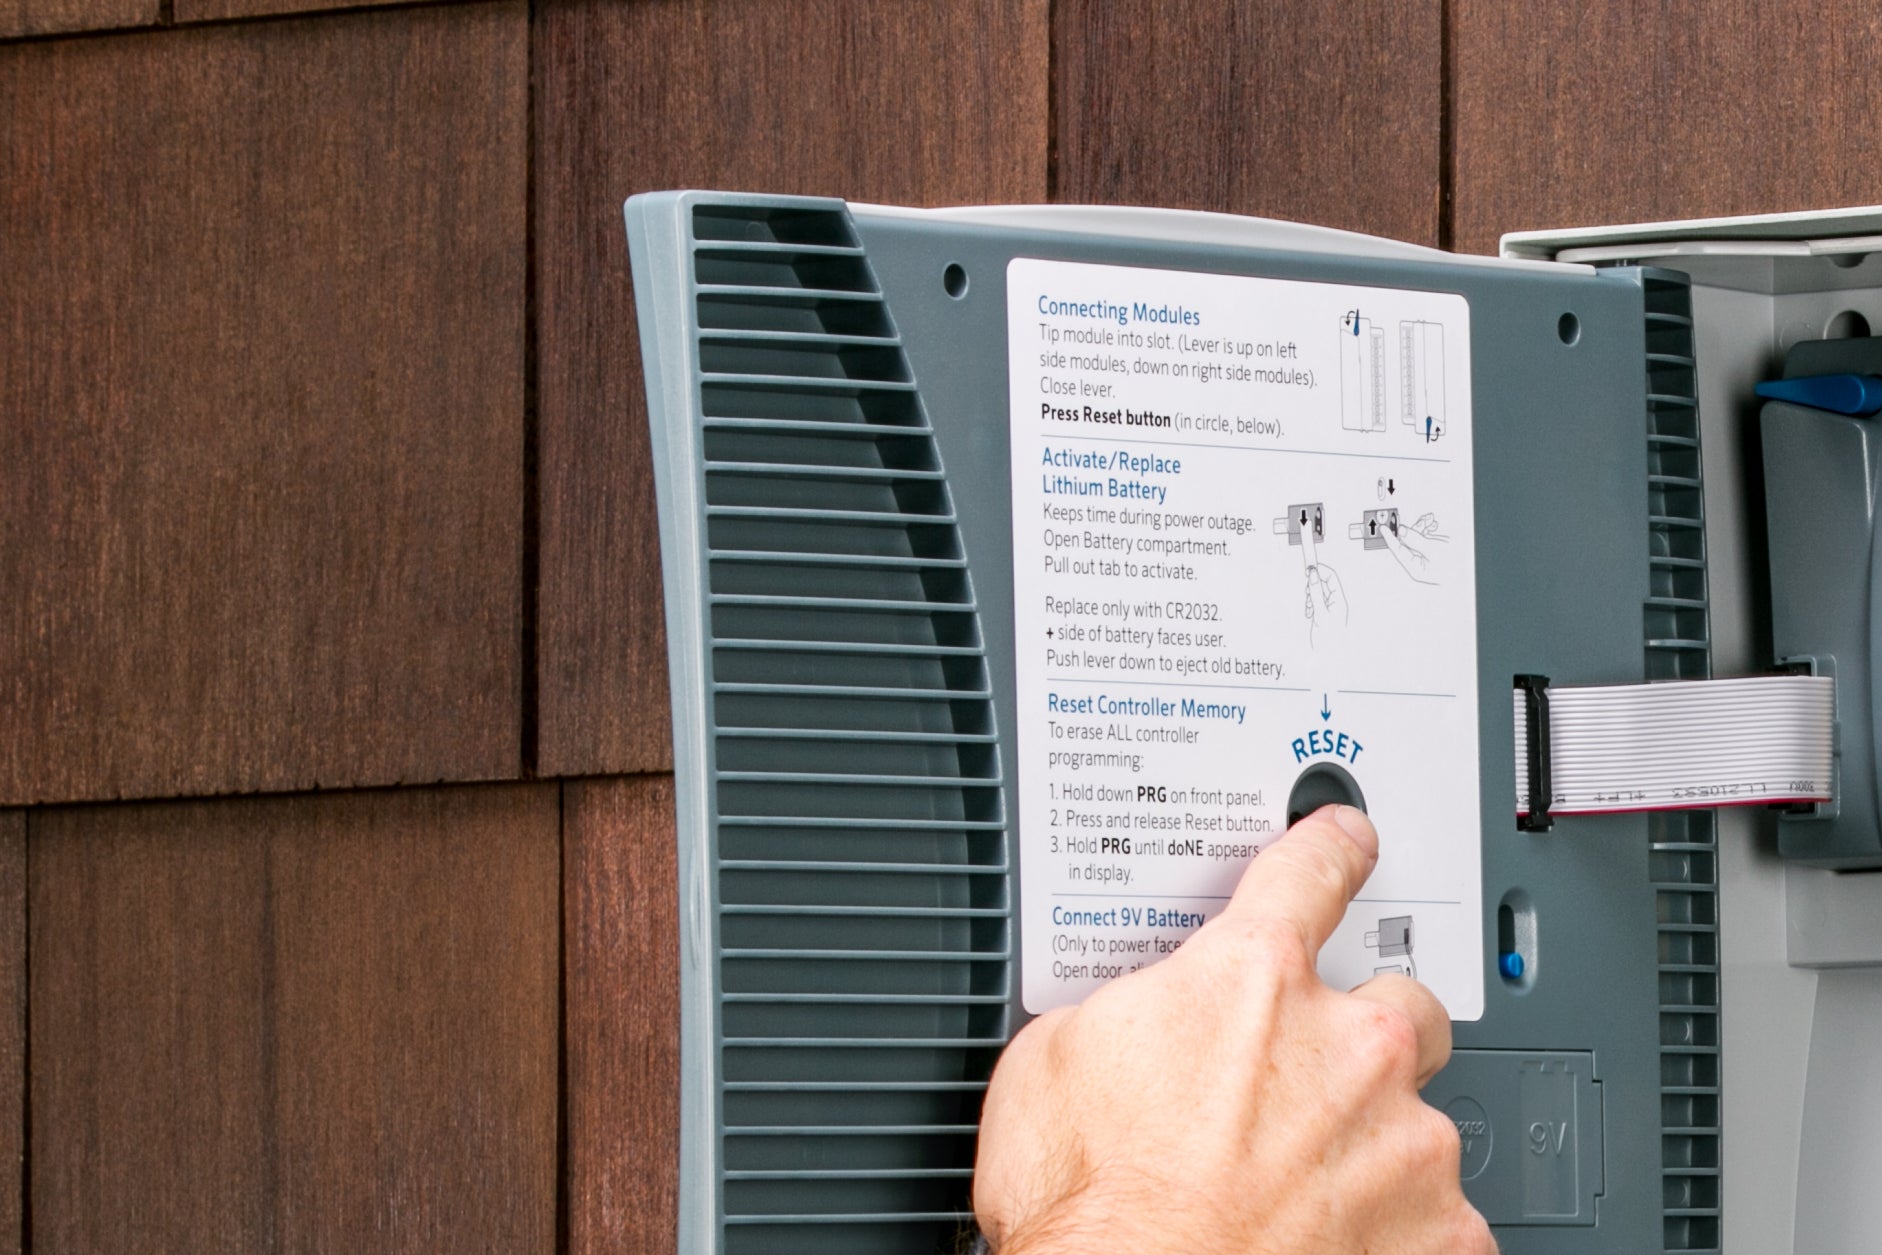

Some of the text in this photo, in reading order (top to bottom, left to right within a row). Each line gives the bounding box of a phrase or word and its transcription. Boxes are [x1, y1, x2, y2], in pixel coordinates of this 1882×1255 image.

[1038, 295, 1200, 326] Connecting Modules
[1039, 323, 1297, 360] Tip module into slot. (Lever is up on left
[1040, 350, 1317, 389] side modules, down on right side modules).
[1040, 376, 1115, 398] Close lever.
[1041, 403, 1284, 439] Press Reset button (in circle, below).
[1042, 446, 1181, 477] Activate/Replace
[1043, 474, 1167, 506] Lithium Battery
[1043, 502, 1255, 535] Keeps time during power outage.
[1044, 529, 1230, 557] Open Battery compartment.
[1045, 555, 1197, 580] Pull out tab to activate.
[1045, 596, 1222, 621] Replace only with CR2032.
[1058, 624, 1085, 641] side
[1088, 624, 1102, 642] of
[1105, 625, 1154, 648] battery
[1157, 627, 1191, 646] faces
[1195, 634, 1226, 647] user.
[1047, 649, 1285, 680] Push lever down to eject old battery.
[1048, 693, 1246, 725] Reset Controller Memory
[1048, 721, 1199, 744] To erase ALL controller
[1292, 729, 1364, 765] RESET
[1049, 751, 1144, 772] programming:
[1049, 782, 1265, 809] 1. Hold down PRG on front panel.
[1050, 809, 1274, 832] 2. Press and release Reset button.
[1051, 835, 1260, 862] 3. Hold PRG until doNE appears
[1069, 863, 1133, 885] in display.
[1052, 906, 1117, 926] Connect
[1121, 907, 1142, 927] 9V
[1053, 935, 1088, 956] (Only
[1092, 938, 1105, 952] to
[1109, 940, 1151, 956] power
[1053, 960, 1089, 982] Open
[1530, 1122, 1567, 1155] 9V
